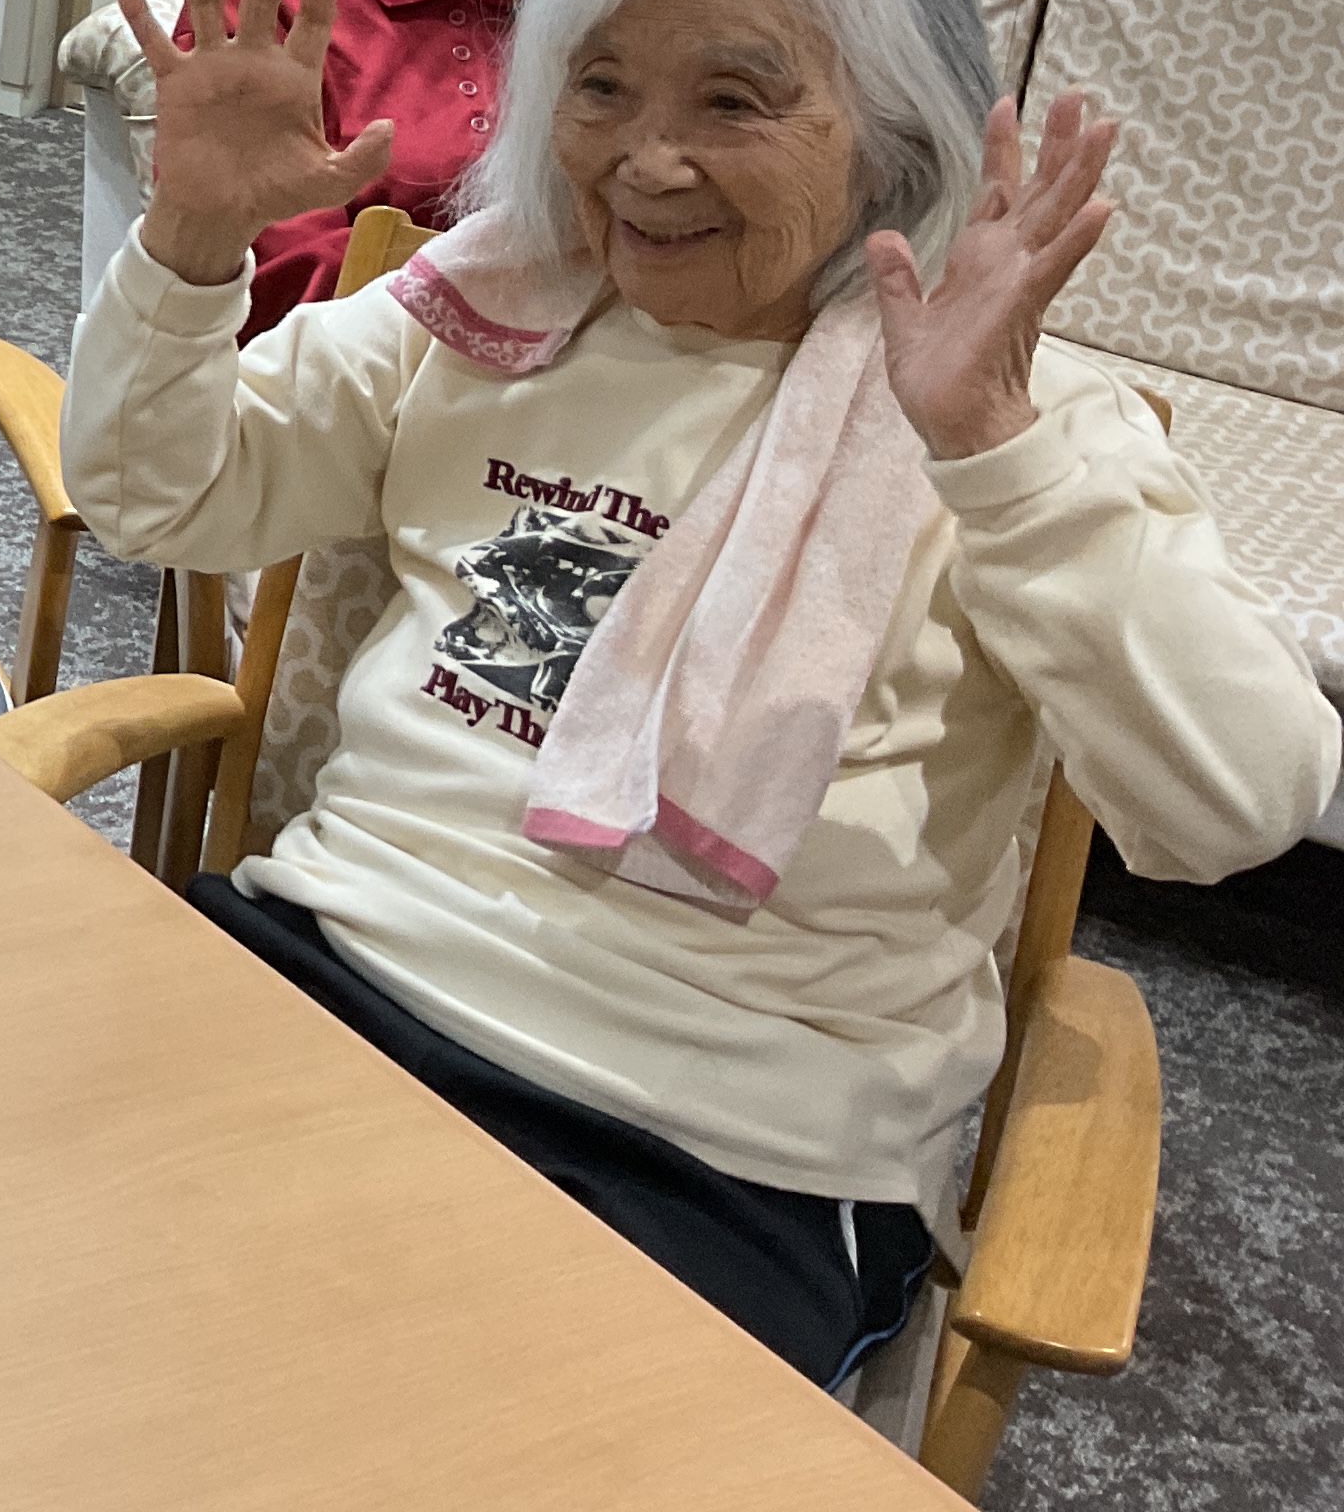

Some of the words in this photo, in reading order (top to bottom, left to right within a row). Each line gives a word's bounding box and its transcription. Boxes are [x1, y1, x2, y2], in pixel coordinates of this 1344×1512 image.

[482, 457, 604, 513] Rewind
[602, 487, 671, 540] The
[419, 662, 494, 728] Play
[493, 698, 548, 749] Th
